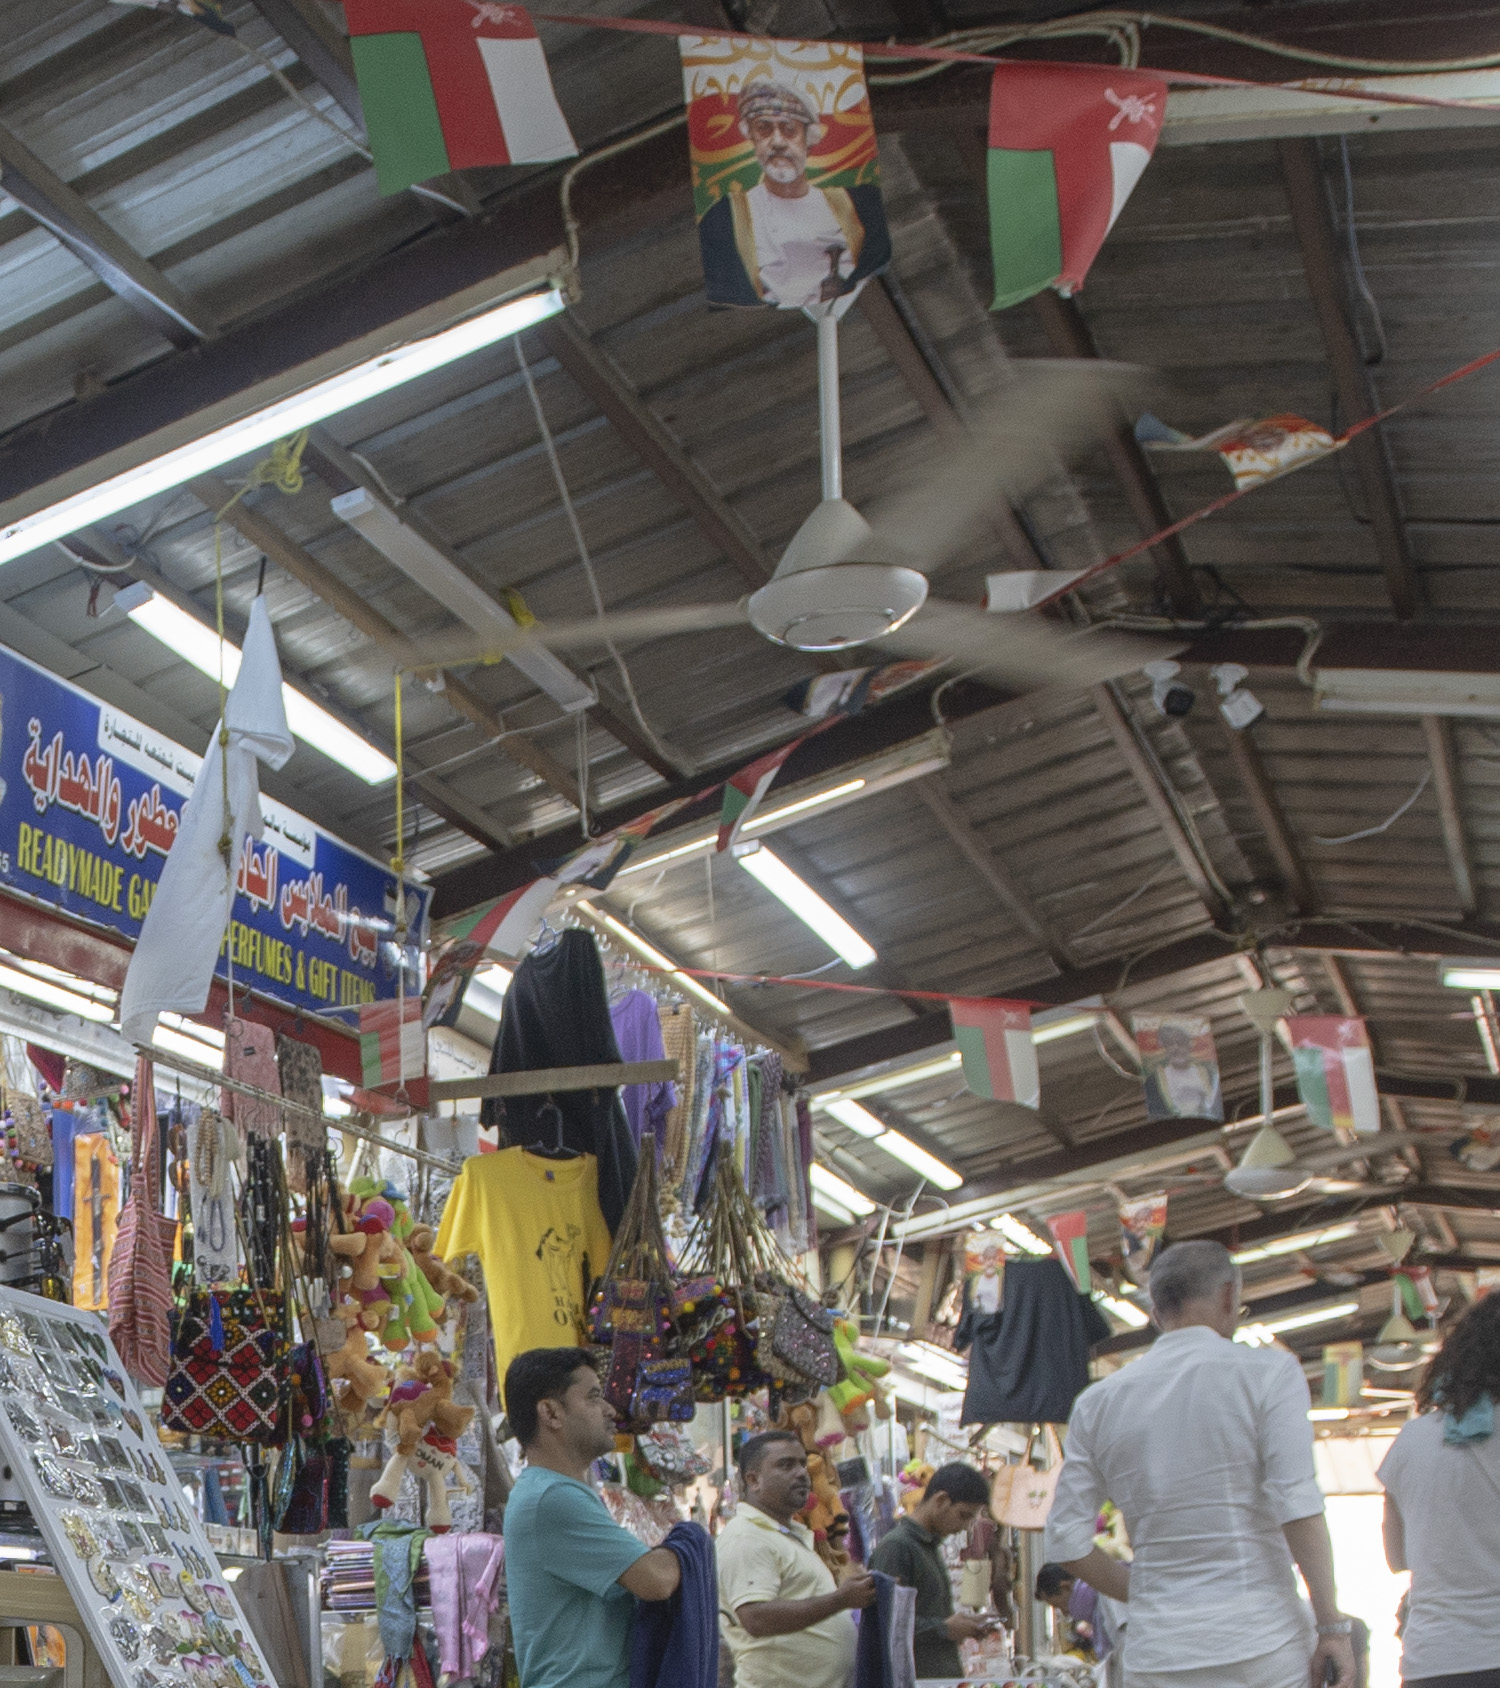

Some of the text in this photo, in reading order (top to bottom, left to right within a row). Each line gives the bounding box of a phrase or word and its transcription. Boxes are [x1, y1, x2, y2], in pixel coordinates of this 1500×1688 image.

[18, 822, 124, 912] READYMADE
[296, 951, 306, 991] &
[309, 957, 339, 1003] GIFT
